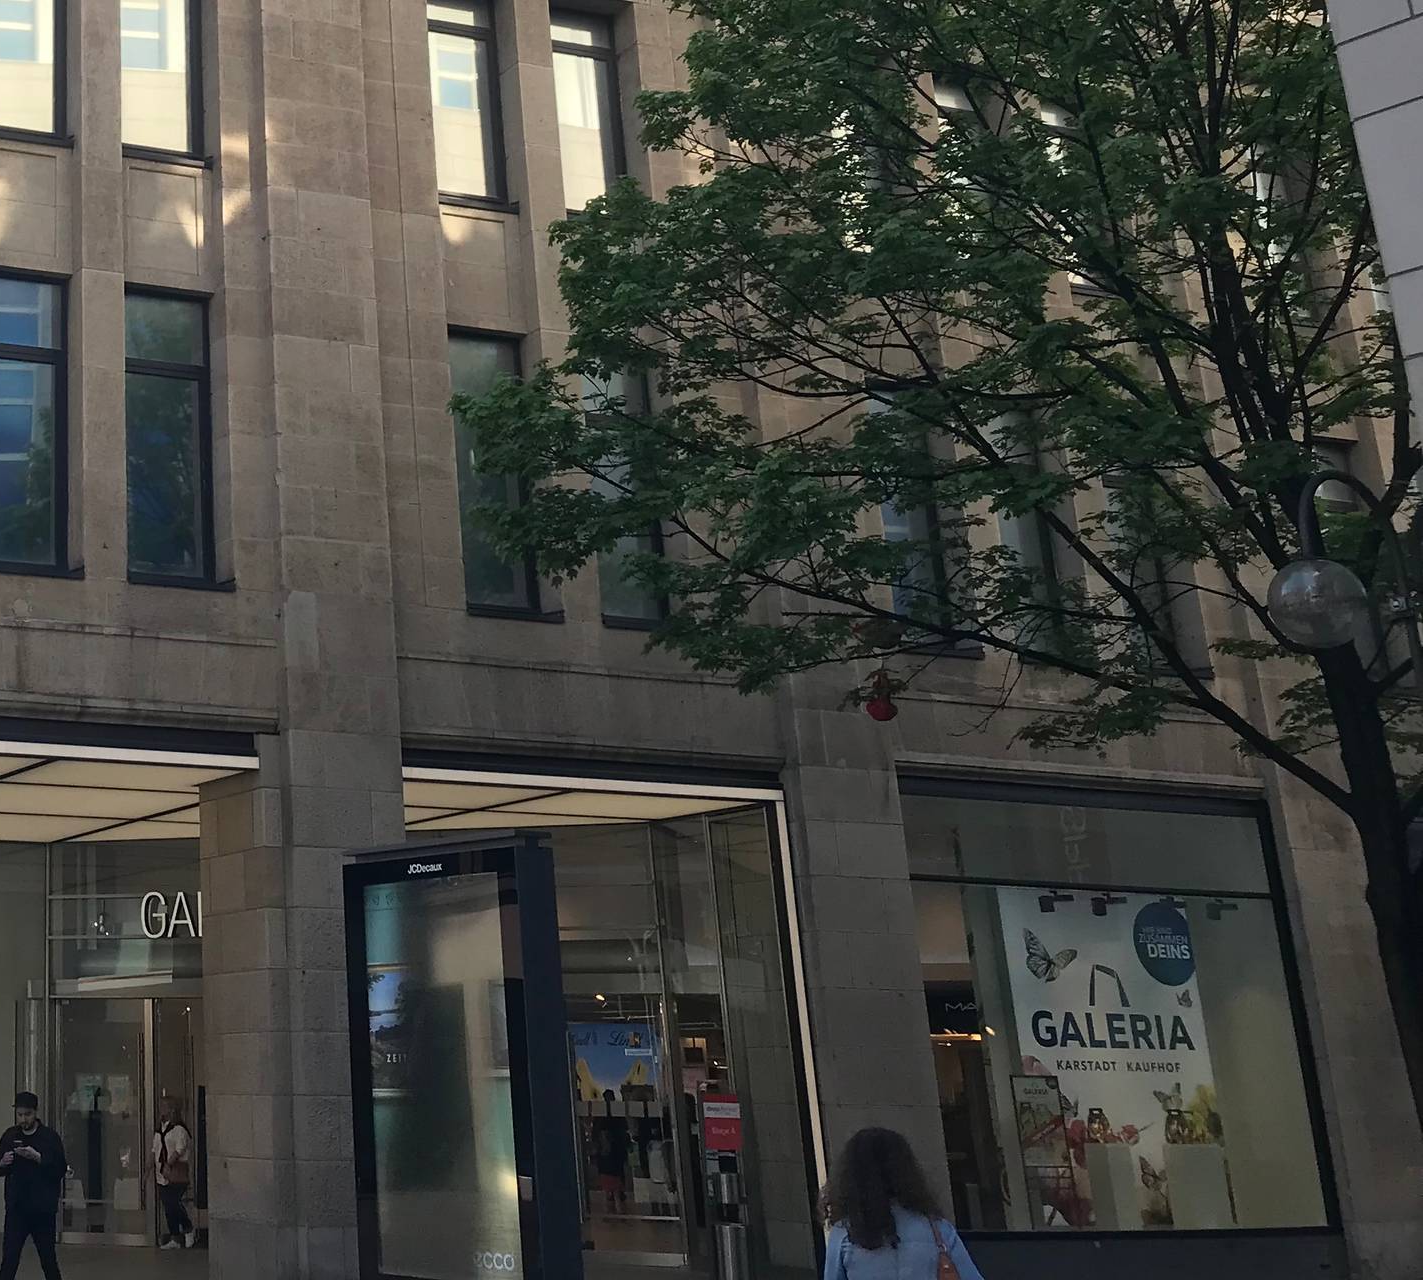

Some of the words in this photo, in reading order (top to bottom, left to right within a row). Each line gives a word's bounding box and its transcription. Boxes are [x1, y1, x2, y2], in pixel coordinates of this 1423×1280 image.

[407, 862, 443, 875] JCDecaux
[1147, 943, 1191, 960] DEINS
[1031, 1009, 1196, 1051] GALERIA
[1056, 1059, 1117, 1072] KARSTADT
[1127, 1061, 1181, 1073] KAUFHOF
